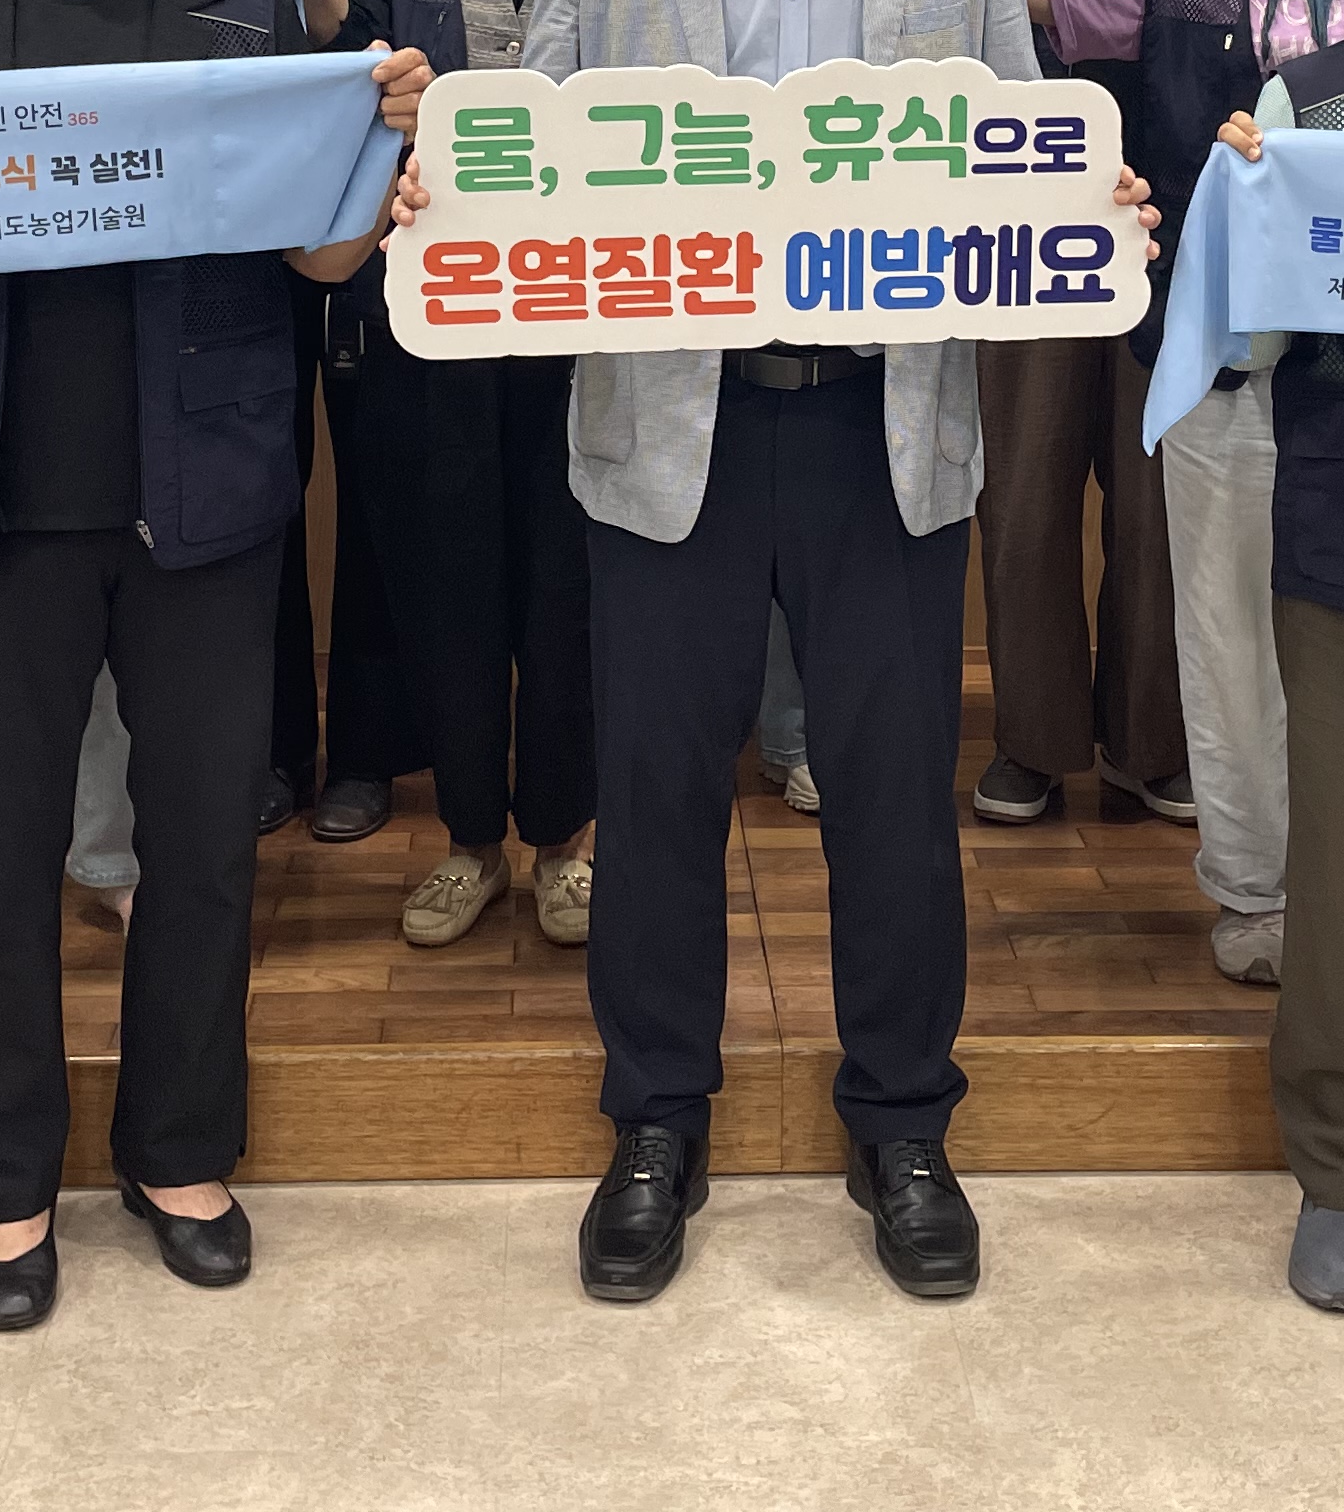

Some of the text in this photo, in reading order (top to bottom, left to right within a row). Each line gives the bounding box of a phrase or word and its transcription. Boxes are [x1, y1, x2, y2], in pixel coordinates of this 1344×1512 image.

[51, 153, 81, 185] 꼭
[89, 148, 165, 182] 실천!
[452, 94, 1087, 197] 물, 그늘, 휴식으로
[421, 224, 1115, 325] 온열질환 예방해요
